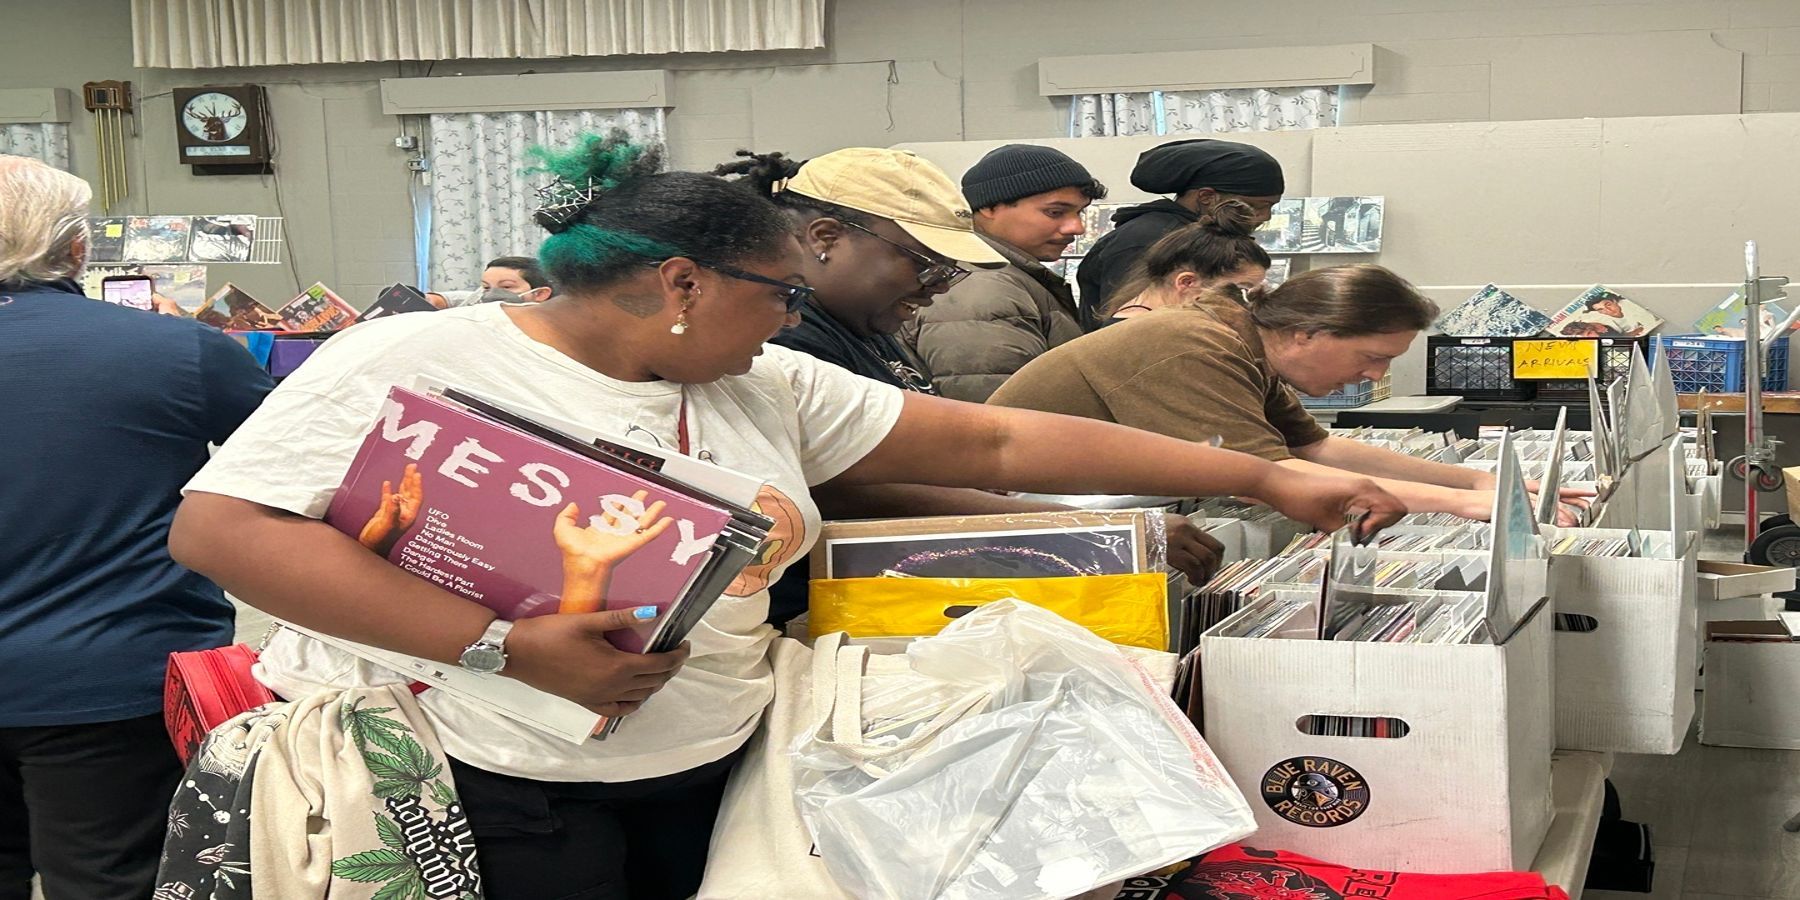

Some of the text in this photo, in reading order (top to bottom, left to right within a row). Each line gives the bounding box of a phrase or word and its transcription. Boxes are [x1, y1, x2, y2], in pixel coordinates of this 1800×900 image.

[1518, 357, 1590, 369] ARRIVALS
[366, 398, 719, 566] MESSY
[426, 515, 448, 528] Dive
[428, 507, 450, 520] UFO
[420, 529, 456, 548] No Man
[424, 522, 484, 550] Ladies Room
[402, 546, 437, 564] Danger
[408, 540, 469, 569] Getting There
[415, 534, 496, 571] Dangerously Easy
[400, 553, 475, 588] The Hardest Part
[404, 564, 432, 578] Could
[431, 574, 445, 584] Be
[454, 584, 484, 600] Florist
[1265, 759, 1363, 793] BLUE RAVEN
[1273, 798, 1361, 824] RECORDS
